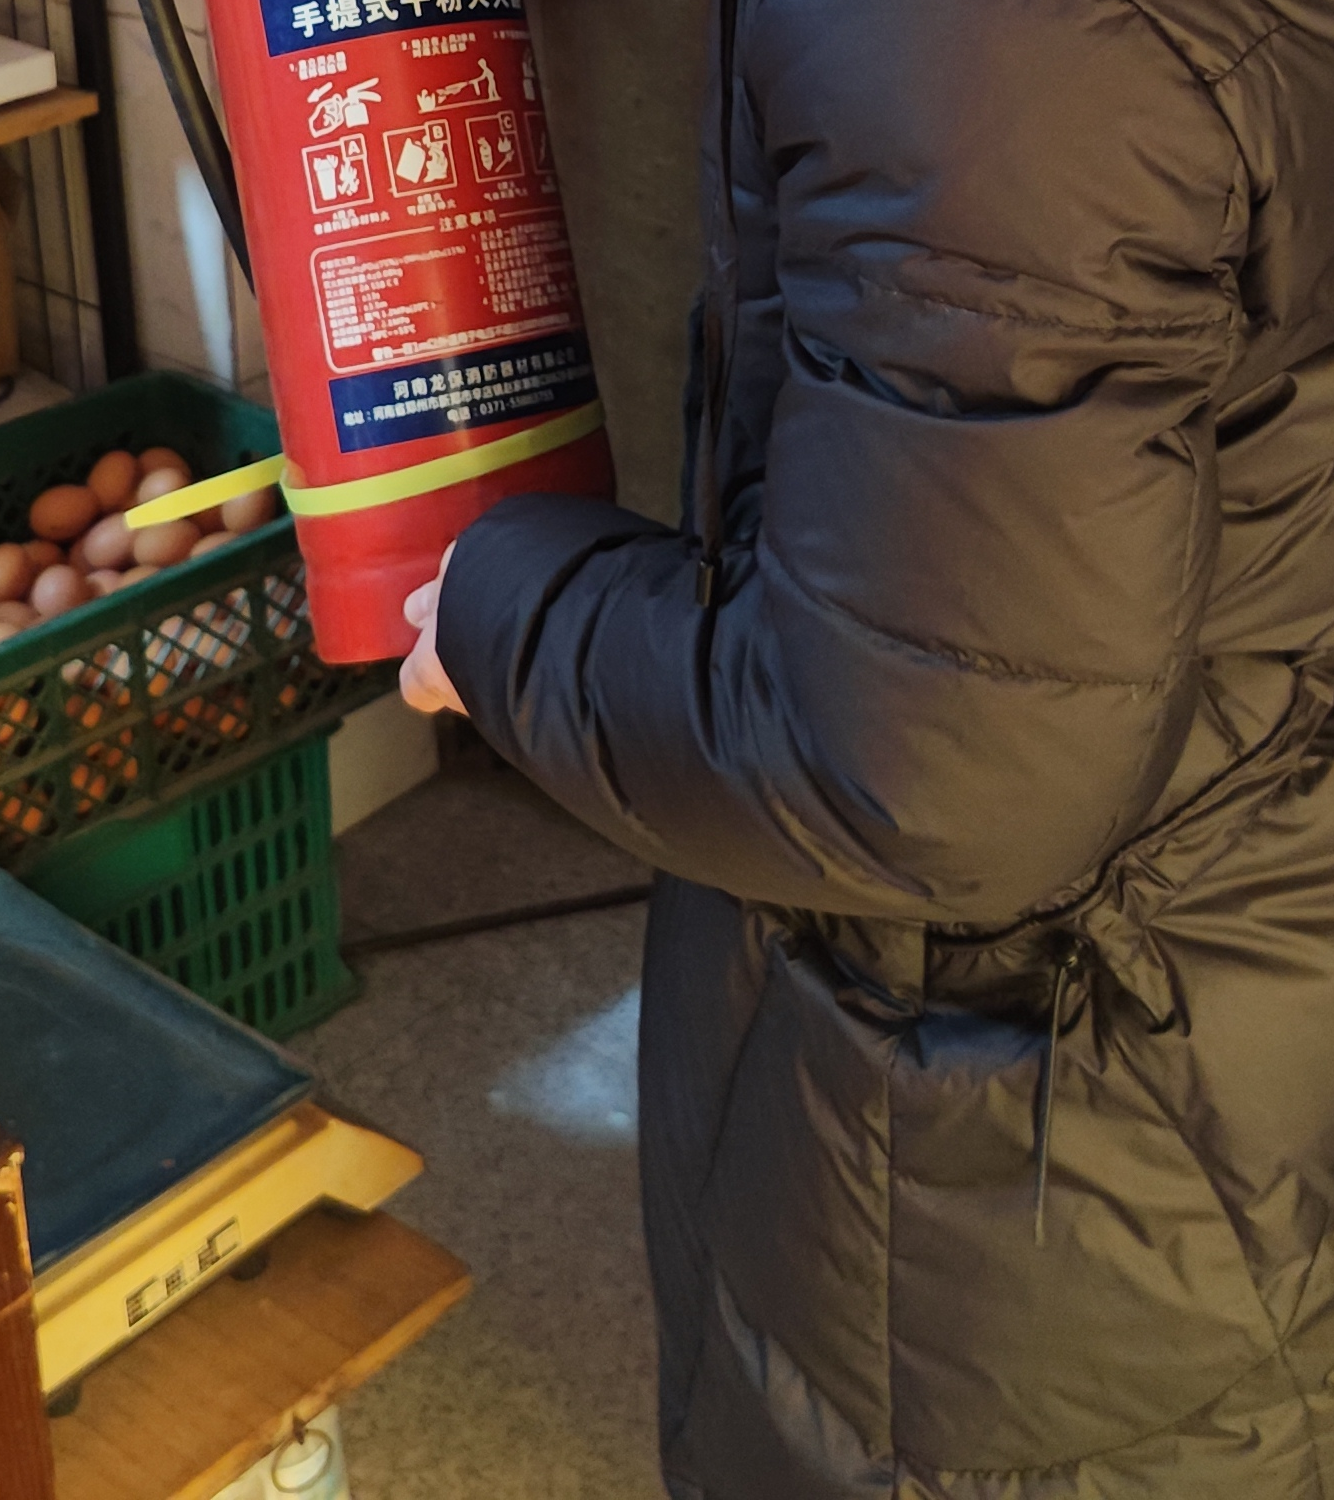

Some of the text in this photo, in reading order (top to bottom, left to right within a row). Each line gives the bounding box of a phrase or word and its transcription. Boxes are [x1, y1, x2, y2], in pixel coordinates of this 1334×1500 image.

[432, 126, 444, 140] B
[348, 142, 360, 156] A
[439, 209, 496, 234] 注意事项
